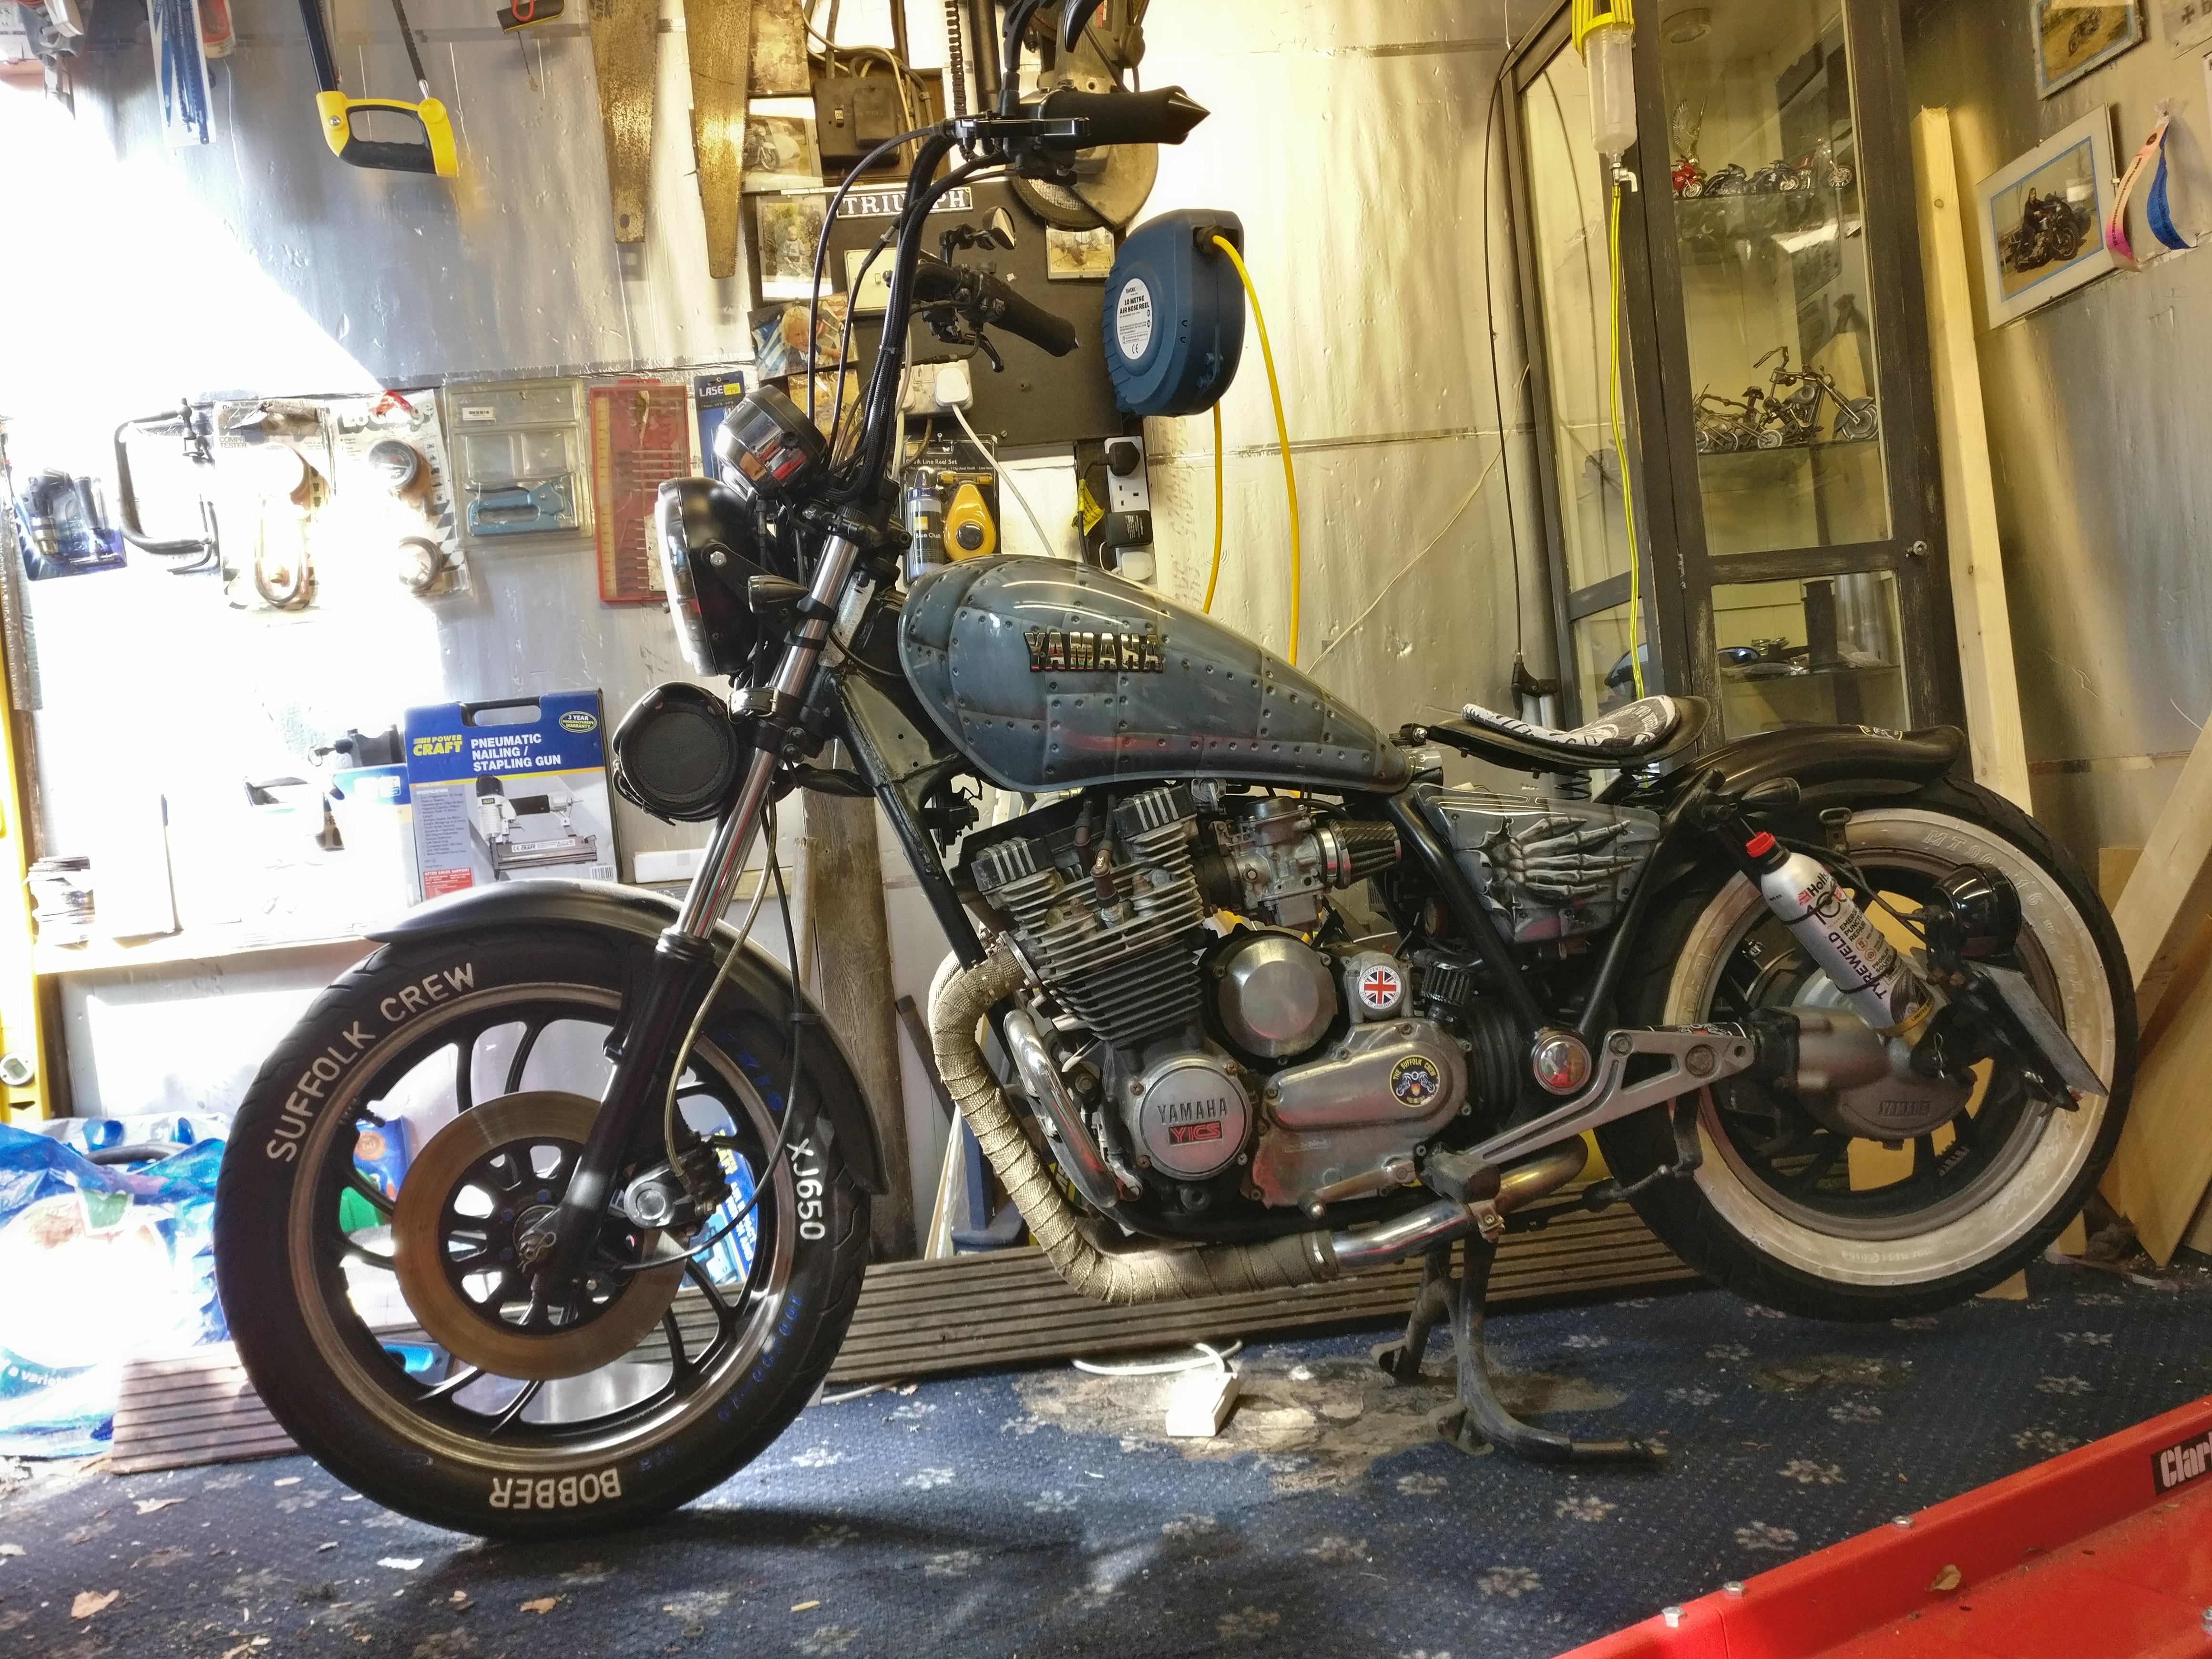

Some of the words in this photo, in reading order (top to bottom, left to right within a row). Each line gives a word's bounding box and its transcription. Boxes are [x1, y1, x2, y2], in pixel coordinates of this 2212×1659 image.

[842, 190, 965, 215] TRIUPH
[1128, 304, 1139, 312] HOSE
[1139, 302, 1149, 310] REEL
[1130, 295, 1145, 305] METRE
[699, 385, 724, 397] LASE
[1024, 632, 1163, 673] YAMAHA
[413, 741, 462, 756] CRAFT
[471, 734, 542, 749] PNEUMATIC
[472, 748, 521, 760] NAILING
[473, 758, 533, 772] STAPLING
[535, 755, 562, 766] GUN
[1096, 856, 1105, 868] NGK
[1849, 921, 1867, 942] REPAIR
[1362, 966, 1393, 980] INDEPENDENCE
[1828, 931, 1887, 1000] TYREWELD
[266, 1021, 376, 1162] SUFFOLK
[380, 963, 474, 1022] CREW
[1393, 1069, 1402, 1080] THE
[1400, 1058, 1423, 1070] SUFFOLK
[1423, 1062, 1436, 1076] CREW
[1157, 1098, 1229, 1124] YAMAHA
[1169, 1122, 1221, 1143] YICS
[787, 1138, 825, 1240] XJ650
[488, 1467, 622, 1509] BOBBER
